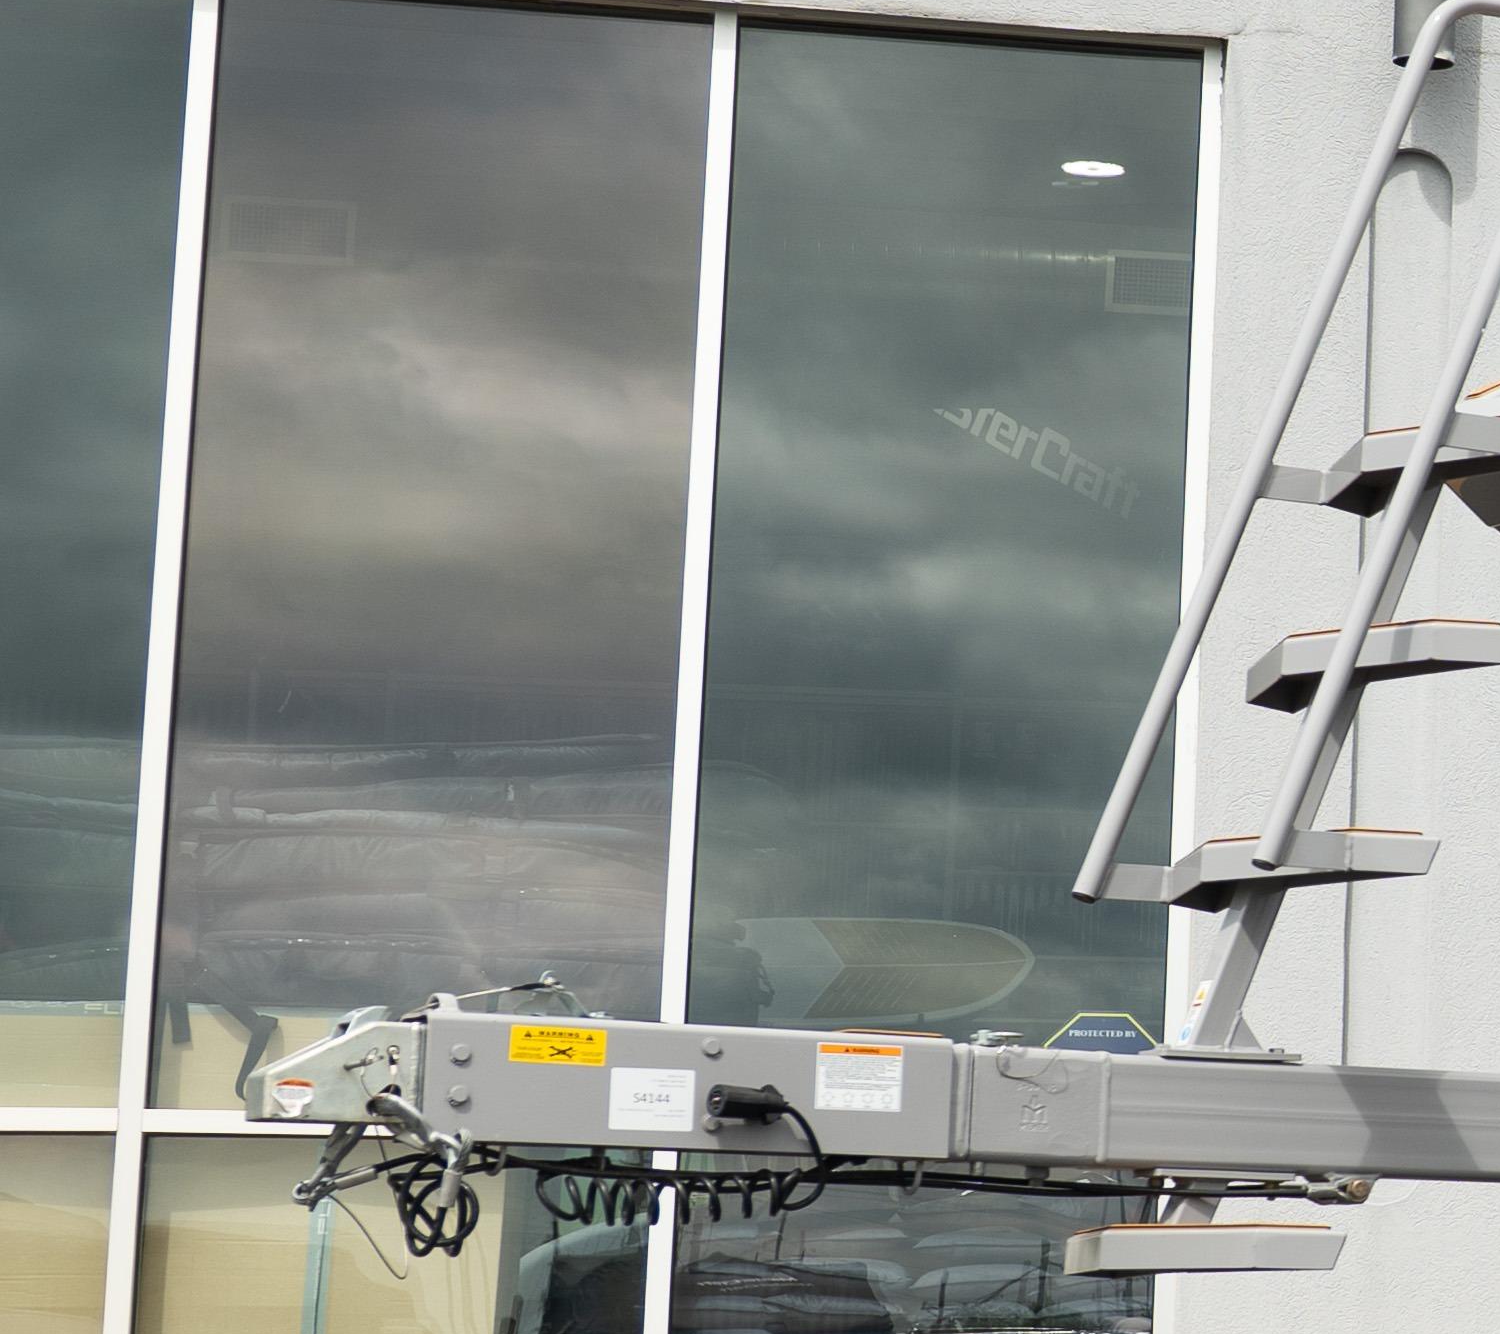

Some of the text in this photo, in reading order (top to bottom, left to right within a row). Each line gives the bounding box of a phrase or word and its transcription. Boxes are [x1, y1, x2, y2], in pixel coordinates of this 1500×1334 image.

[932, 407, 1141, 519] sterCraft
[1068, 1028, 1137, 1038] PROTECTED BY
[633, 1092, 671, 1104] S4144
